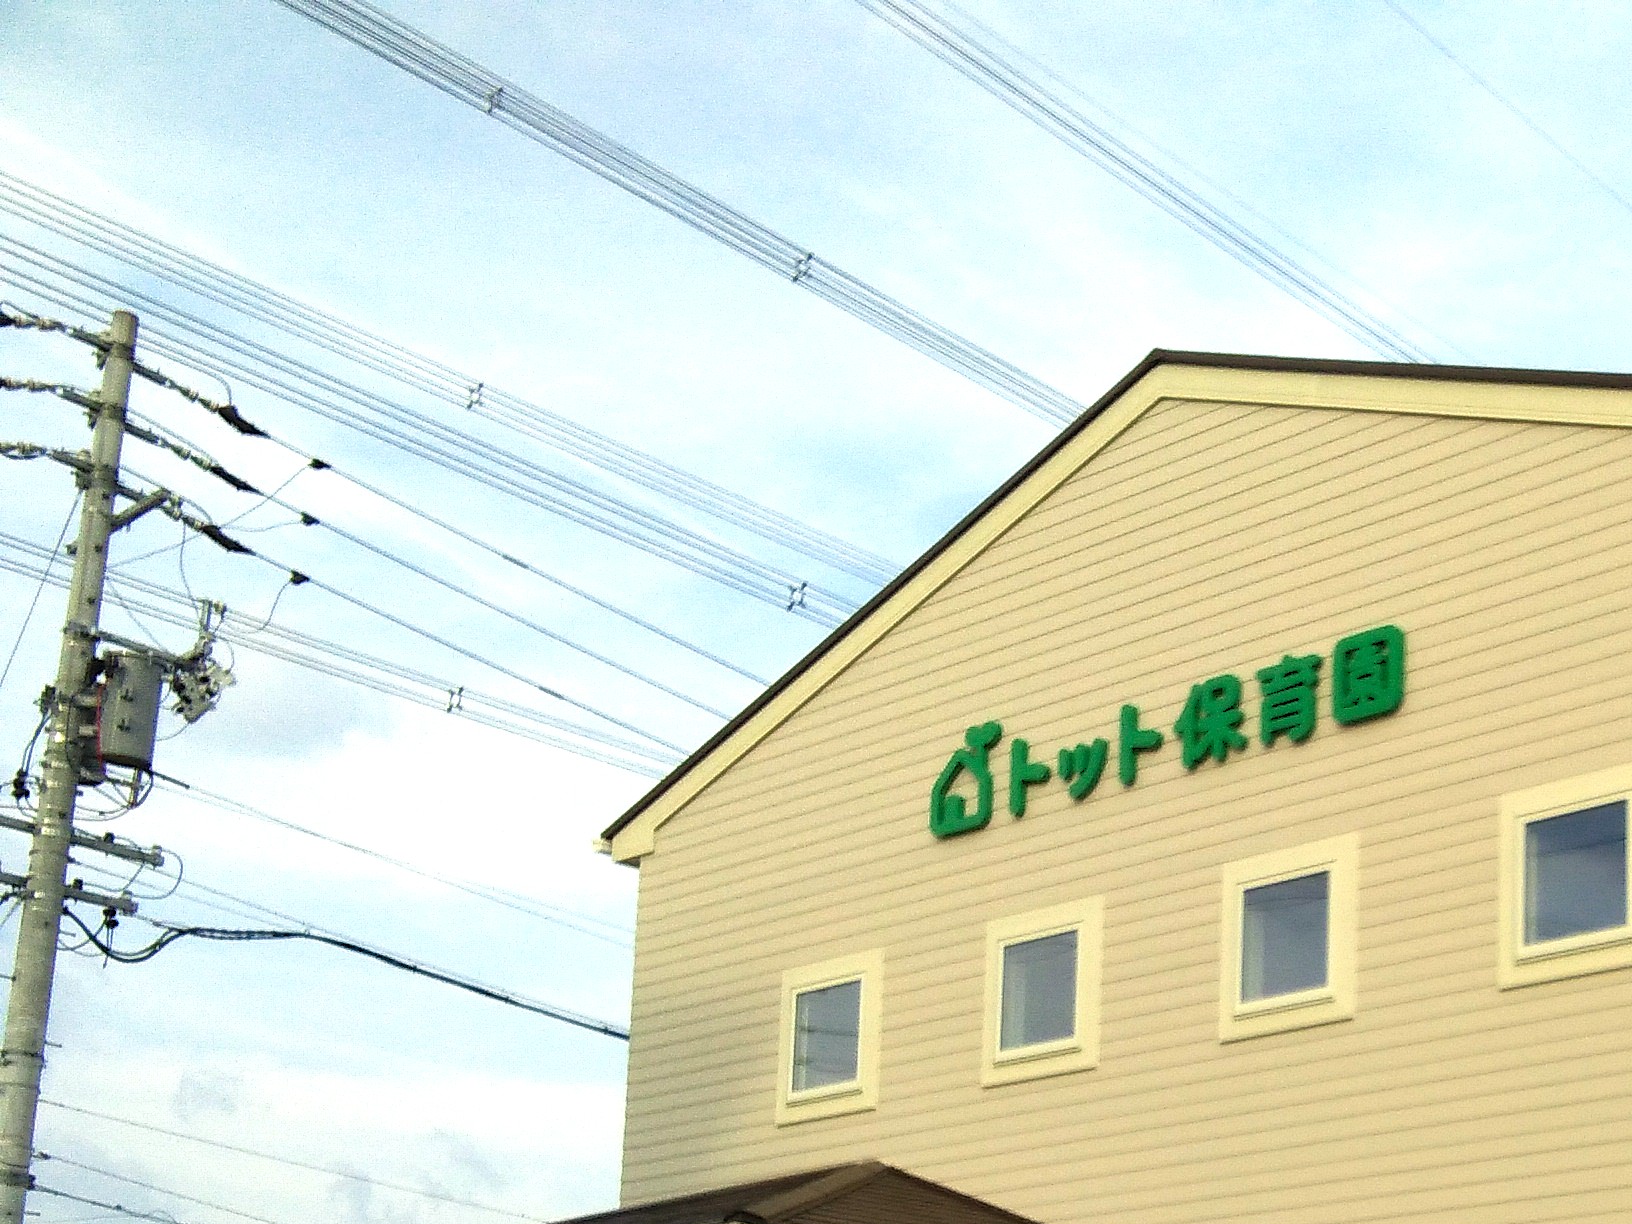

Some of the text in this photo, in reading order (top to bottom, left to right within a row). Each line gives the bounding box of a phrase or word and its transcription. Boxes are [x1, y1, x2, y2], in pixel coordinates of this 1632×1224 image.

[1009, 625, 1404, 817] トット保育園
